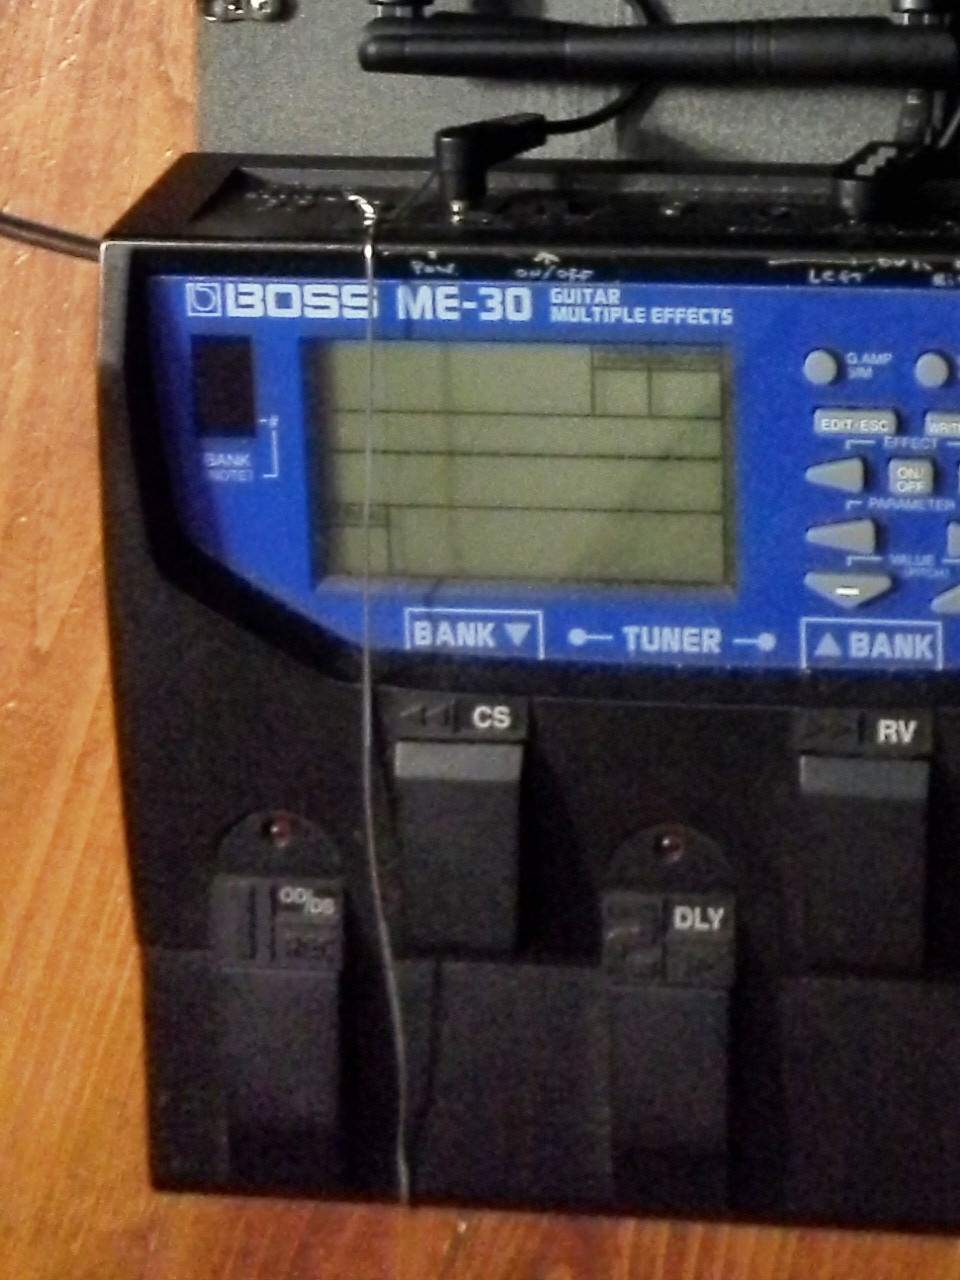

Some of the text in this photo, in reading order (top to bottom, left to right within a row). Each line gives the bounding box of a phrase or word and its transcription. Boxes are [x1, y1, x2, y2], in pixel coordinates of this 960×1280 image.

[225, 283, 534, 322] BOSS ME-30
[549, 287, 621, 306] GUITAR
[550, 306, 734, 326] MULTIPLE EFFECTS
[883, 435, 939, 450] EFFECT
[205, 452, 251, 468] BANK
[867, 497, 956, 512] PARAMETER
[413, 620, 495, 648] BANK
[623, 625, 722, 653] TUNER
[848, 631, 935, 660] BANK
[471, 704, 512, 730] CS
[876, 719, 918, 745] RV
[673, 905, 725, 933] DLY
